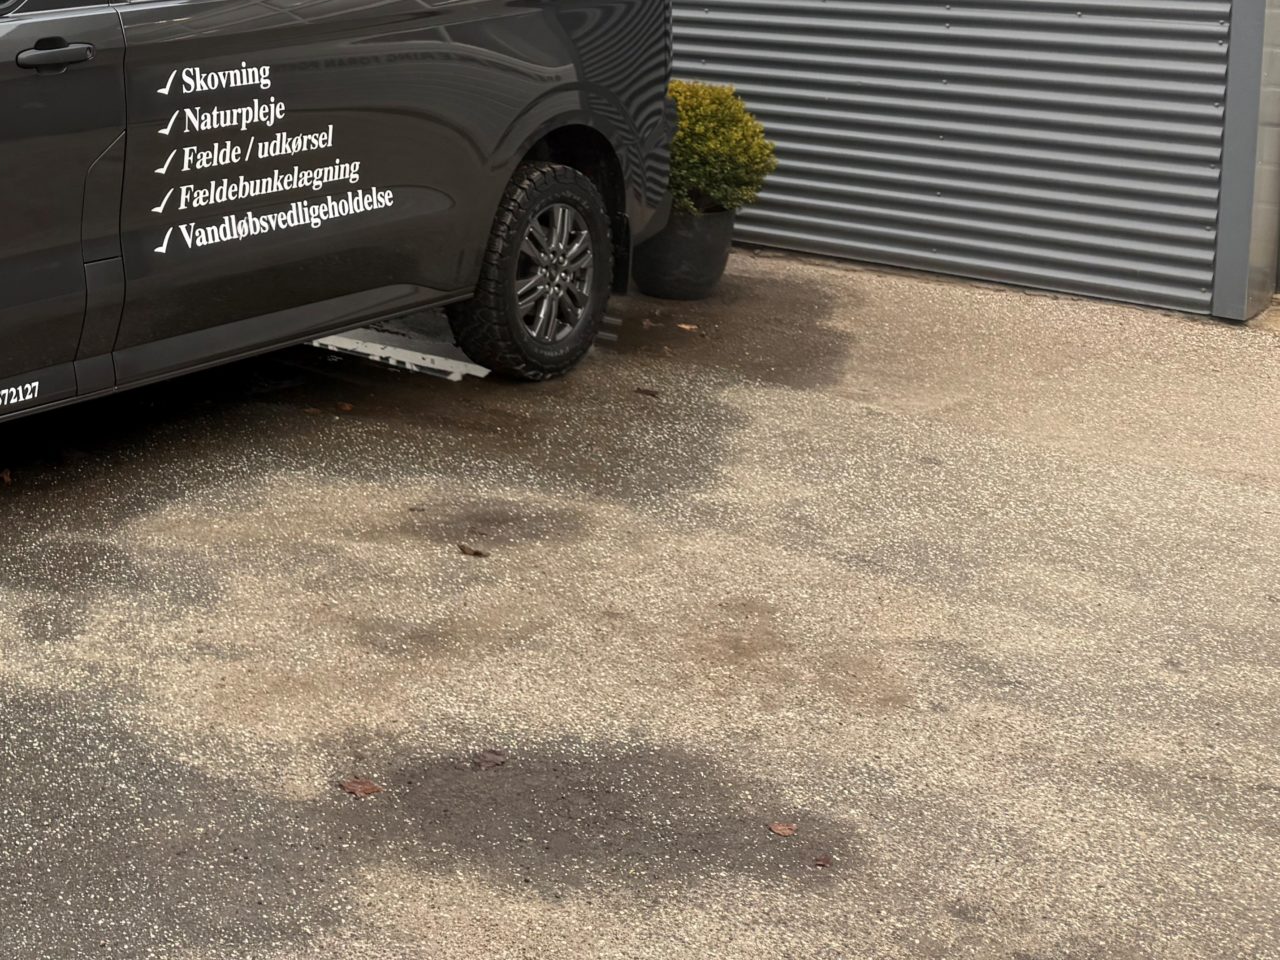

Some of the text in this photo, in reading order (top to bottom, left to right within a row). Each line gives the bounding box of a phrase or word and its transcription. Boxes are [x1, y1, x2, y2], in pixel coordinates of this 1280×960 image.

[181, 61, 271, 94] Skovning
[183, 96, 285, 133] Naturpleje
[181, 141, 241, 172] Fælde
[257, 124, 334, 159] udkørsel
[178, 158, 360, 210] Fældebunkelægning
[179, 187, 394, 249] Vandløbsvedligeholdelse
